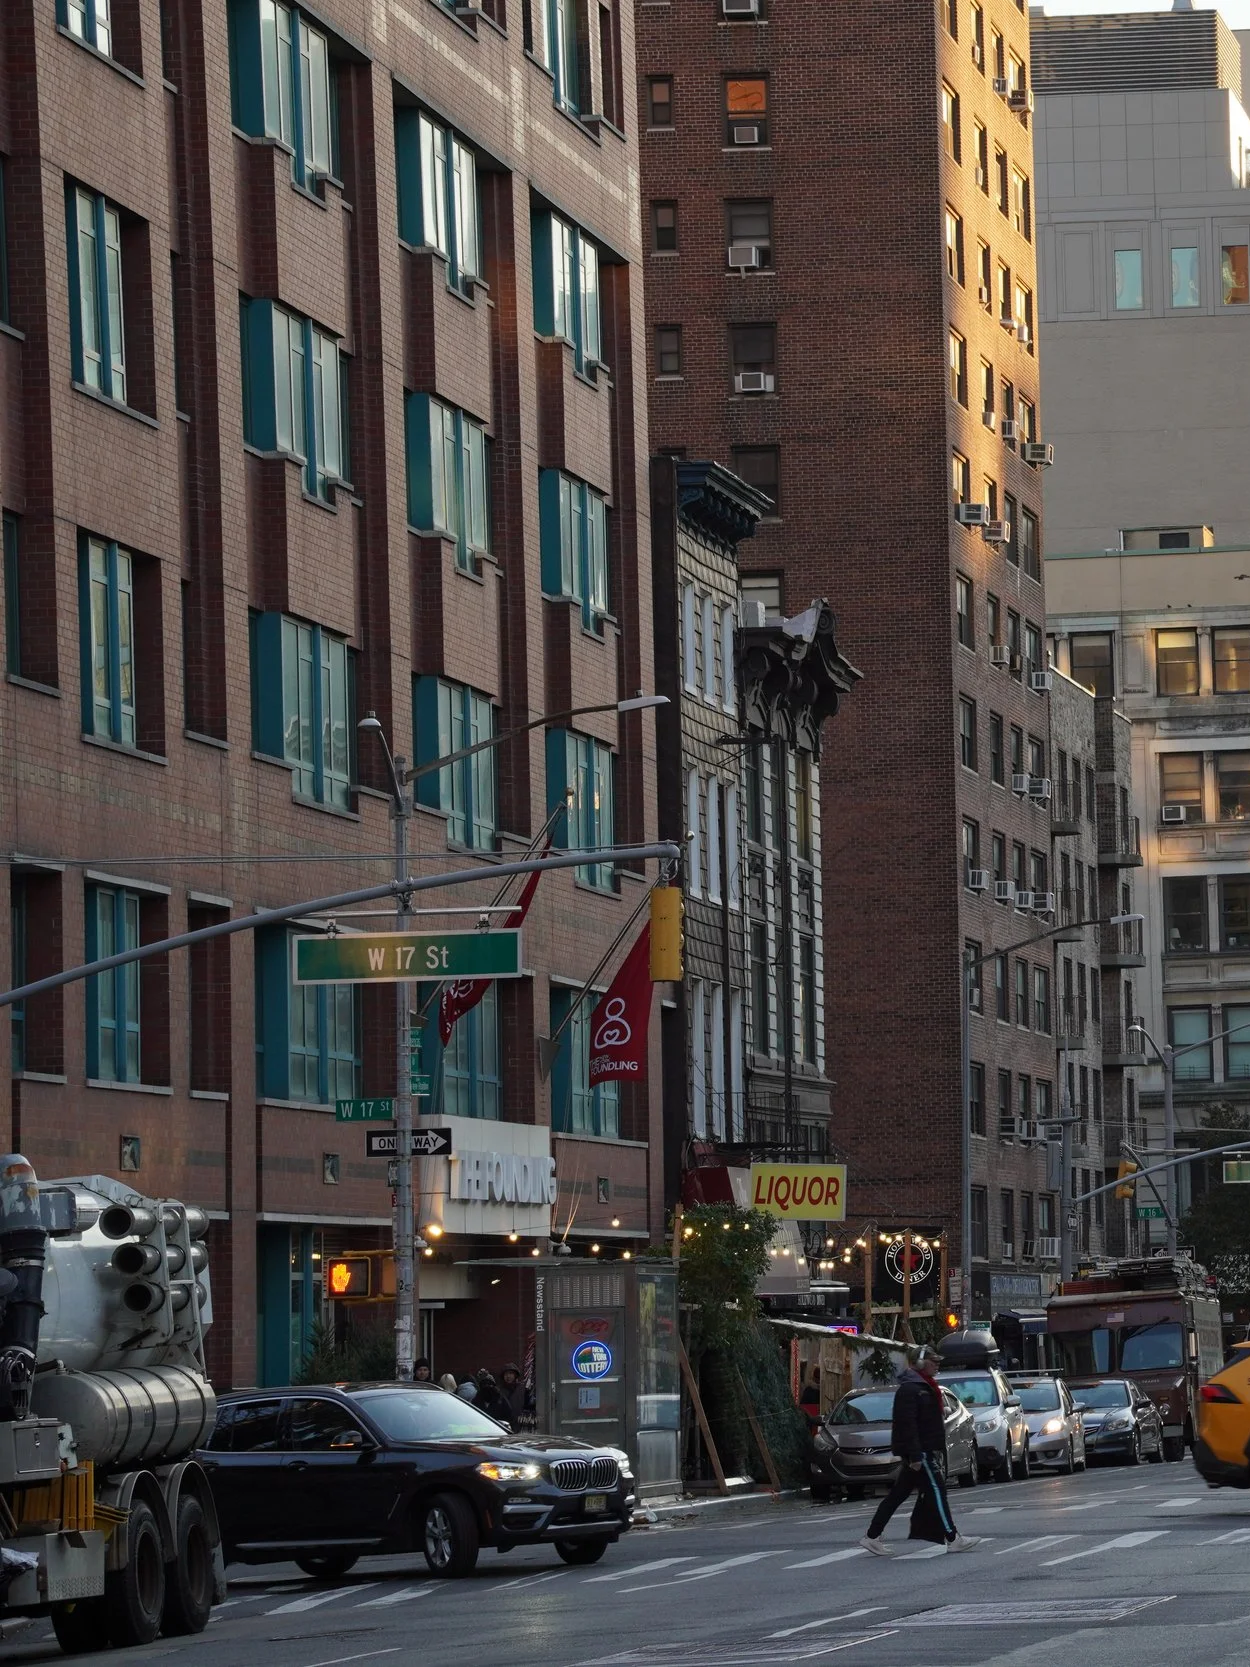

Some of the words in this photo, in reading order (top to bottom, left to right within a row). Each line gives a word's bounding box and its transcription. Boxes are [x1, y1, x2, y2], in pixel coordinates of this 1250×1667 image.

[367, 947, 385, 971] W
[395, 946, 416, 970] 17
[425, 945, 449, 969] St
[340, 1102, 354, 1118] W
[360, 1101, 374, 1117] 17
[380, 1100, 389, 1111] St
[378, 1138, 397, 1149] ON
[413, 1136, 439, 1148] WAY
[449, 1150, 489, 1200] THE
[488, 1151, 557, 1204] FOUNDLING
[754, 1175, 840, 1211] LIQUOR
[1138, 1208, 1145, 1217] W
[1148, 1208, 1156, 1217] 16
[887, 1236, 931, 1260] HOLLWOD
[536, 1276, 545, 1332] Newsstand
[577, 1361, 608, 1373] LOTTERY
[592, 1353, 607, 1361] YORK
